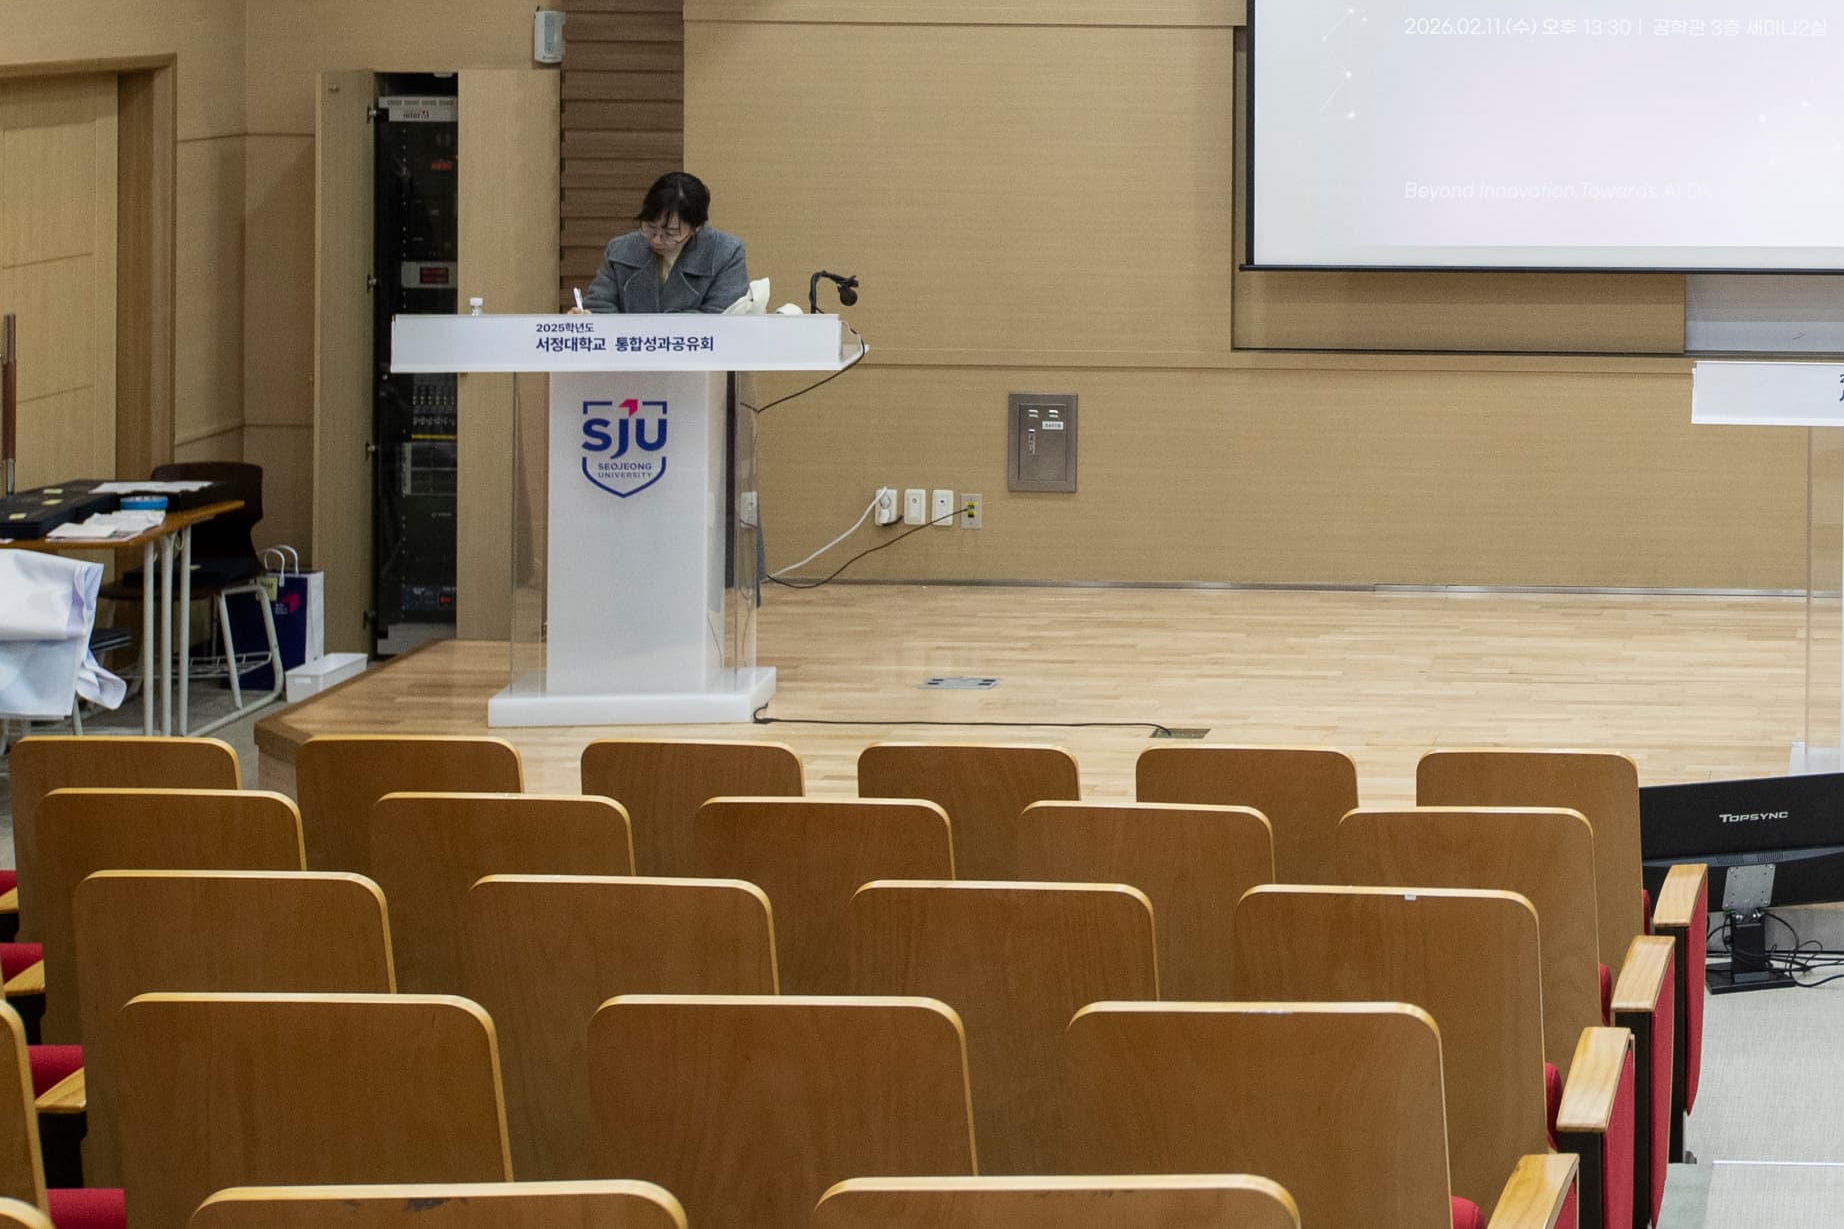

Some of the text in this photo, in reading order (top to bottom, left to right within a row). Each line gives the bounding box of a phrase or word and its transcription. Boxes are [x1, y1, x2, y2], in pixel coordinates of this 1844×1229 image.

[1541, 17, 1577, 36] 오후
[1652, 18, 1706, 37] 공학관
[1403, 181, 1475, 202] Beyond
[536, 322, 595, 333] 2025학년도
[535, 336, 715, 353] 서정대학교 통합성과공유회
[598, 463, 652, 471] SEOJEONG
[1719, 811, 1789, 823] TOPSYNC
